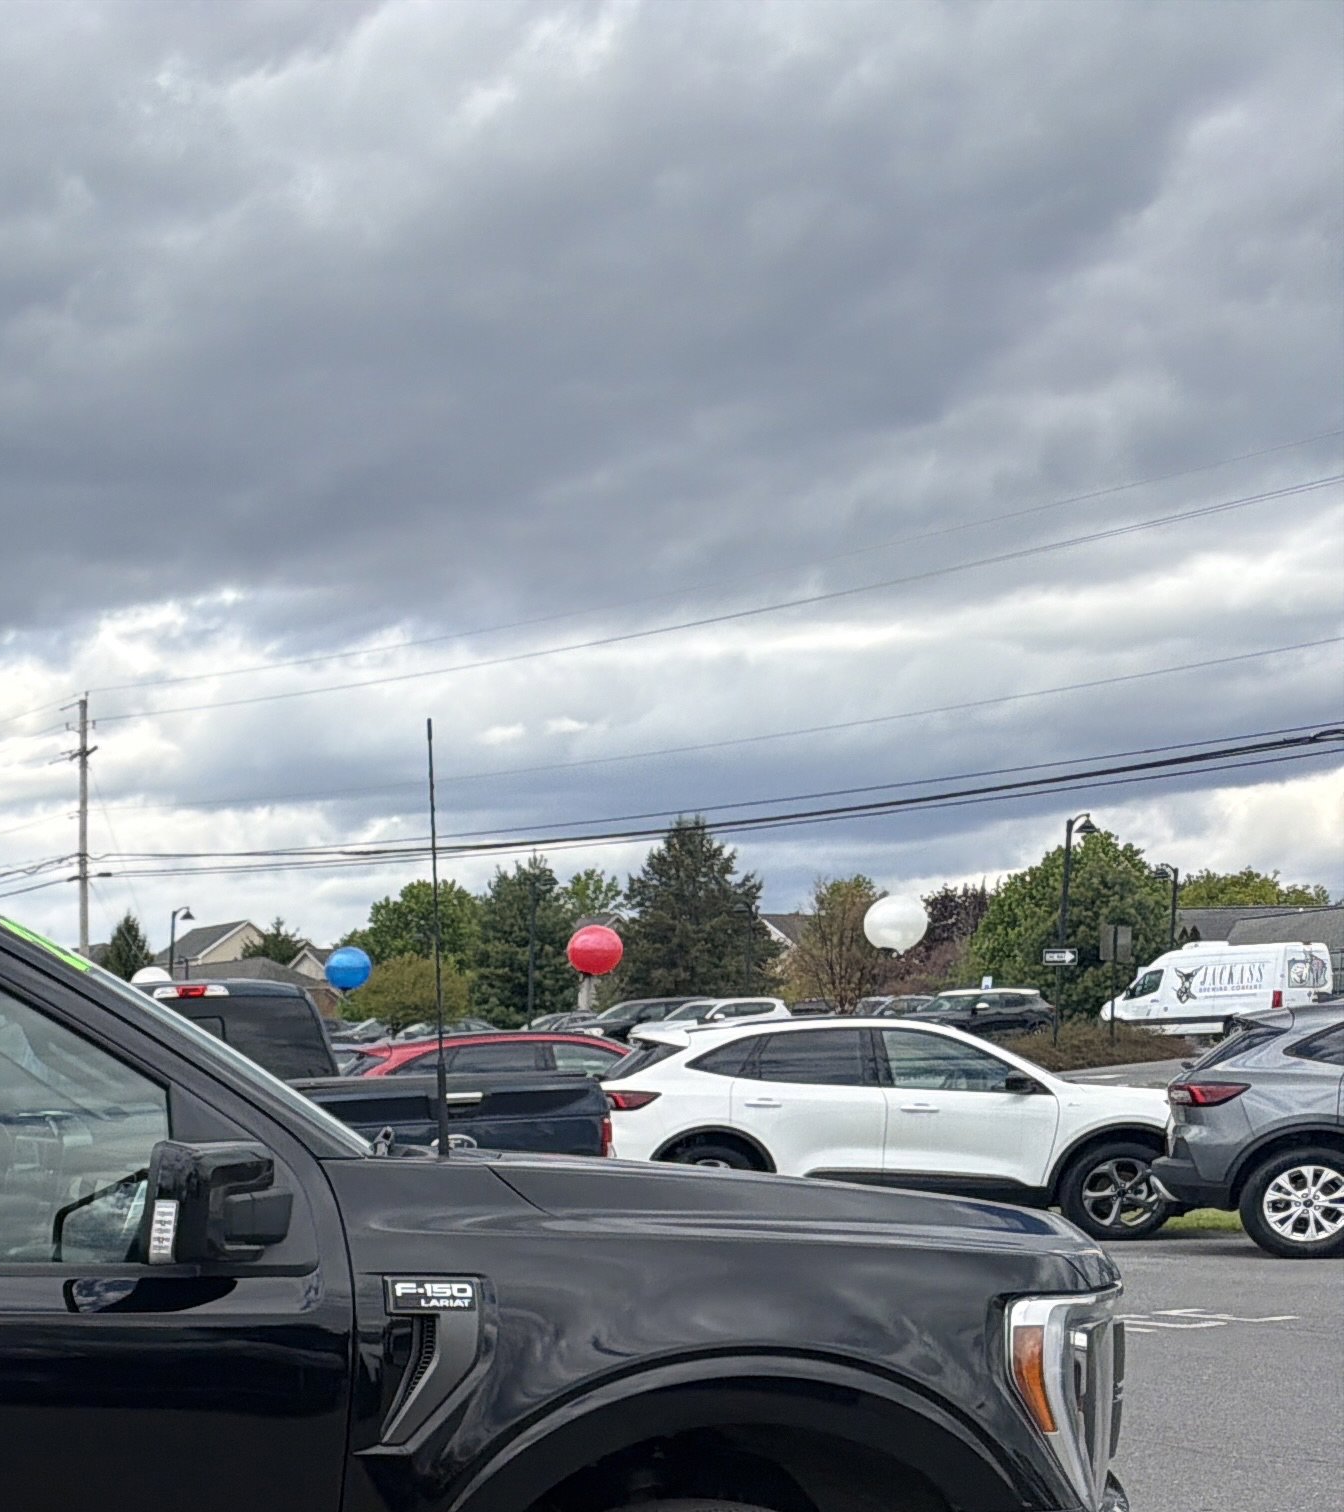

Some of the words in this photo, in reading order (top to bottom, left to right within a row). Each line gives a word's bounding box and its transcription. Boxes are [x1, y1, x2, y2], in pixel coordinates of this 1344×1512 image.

[1200, 963, 1264, 986] JACKASS
[1231, 983, 1263, 992] COMPANY
[395, 1283, 473, 1297] F-150
[421, 1299, 472, 1308] LARIAT
